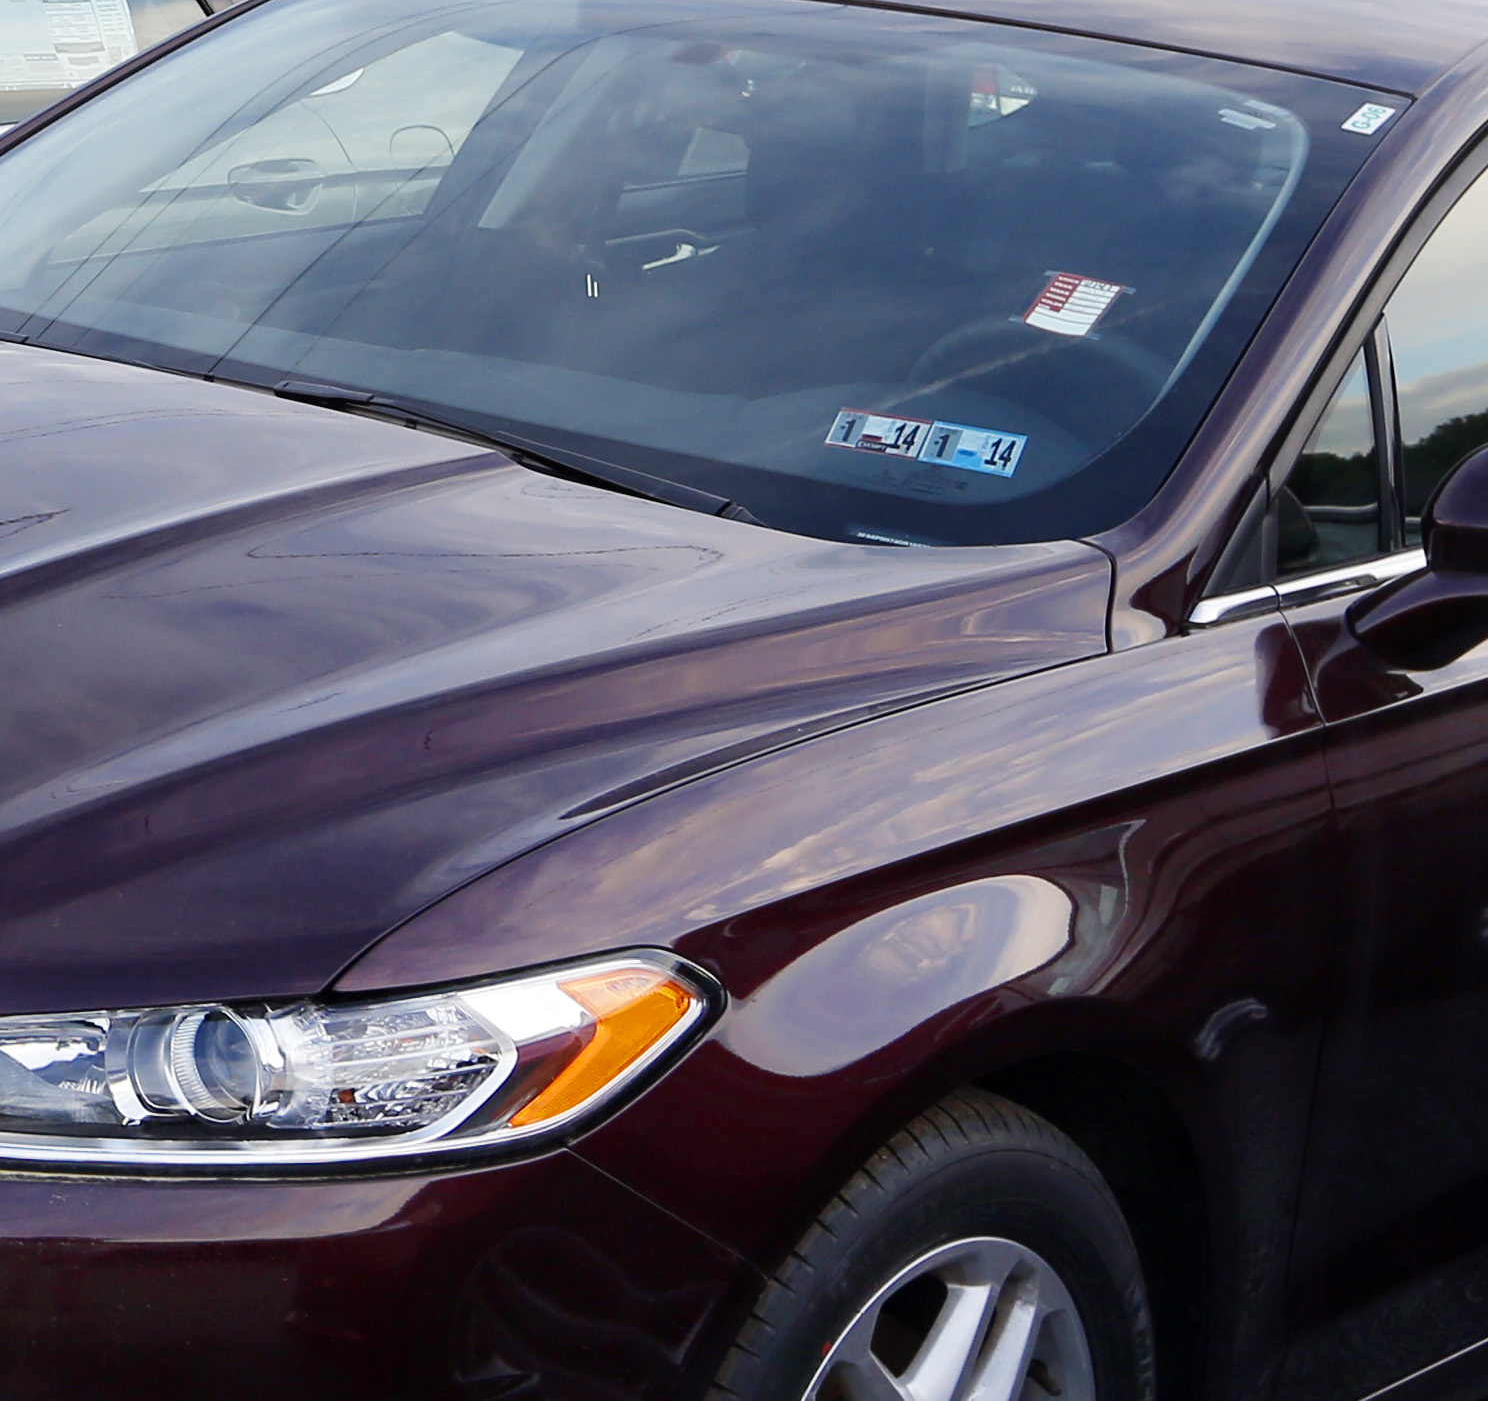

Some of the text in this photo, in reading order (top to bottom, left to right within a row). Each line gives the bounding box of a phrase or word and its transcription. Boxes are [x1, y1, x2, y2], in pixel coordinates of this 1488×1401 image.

[1351, 106, 1386, 129] G-06
[887, 422, 921, 454] 14
[984, 437, 1017, 471] 14
